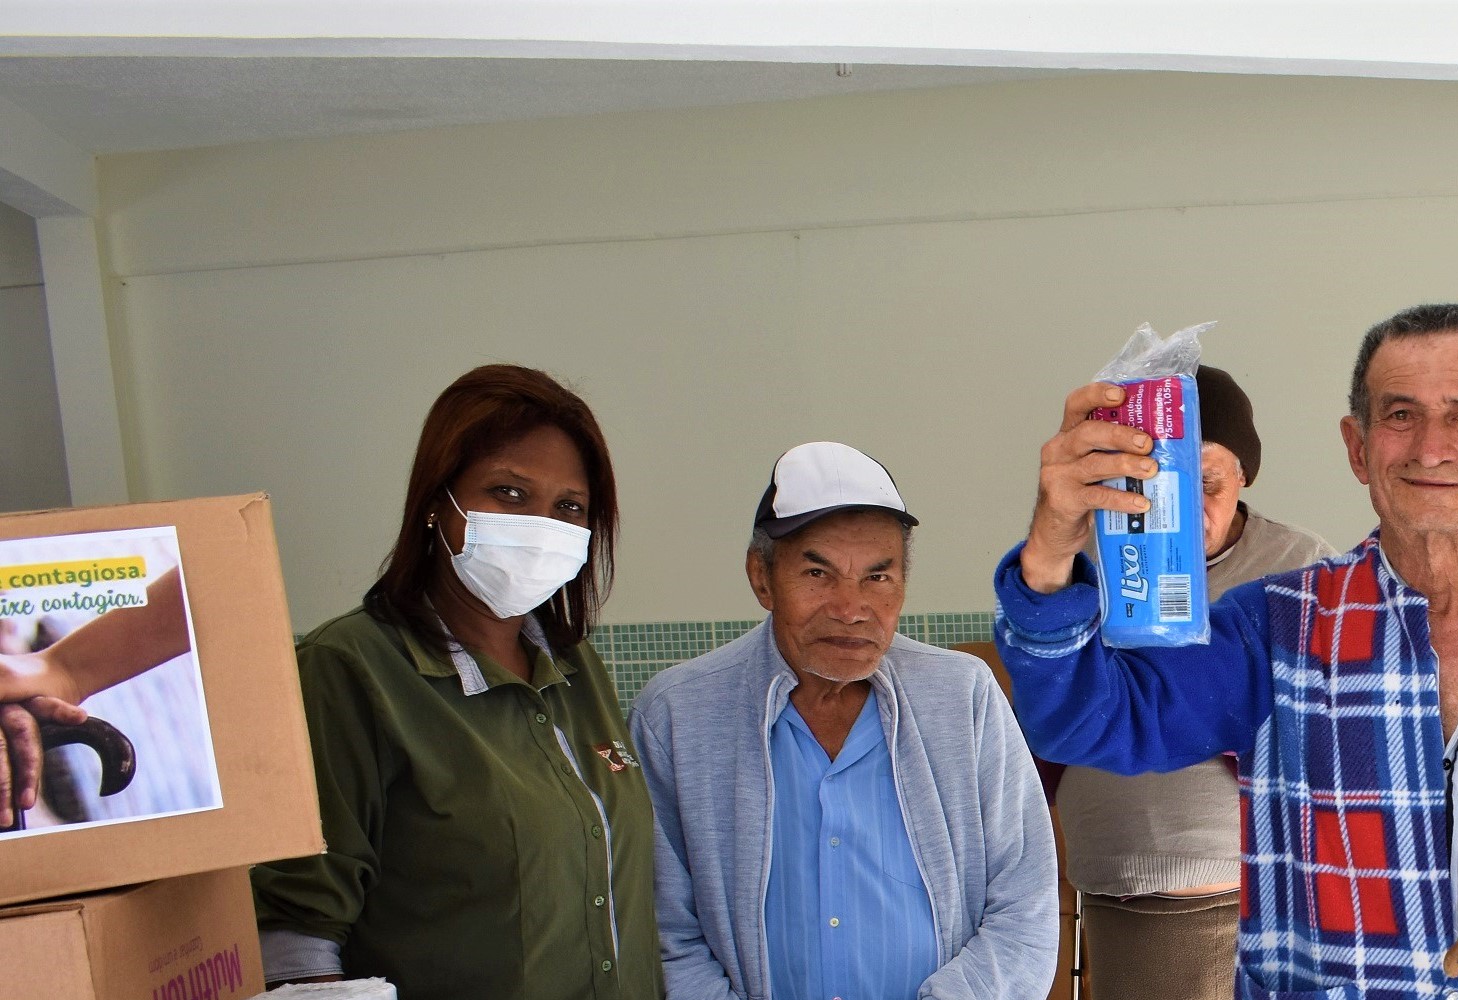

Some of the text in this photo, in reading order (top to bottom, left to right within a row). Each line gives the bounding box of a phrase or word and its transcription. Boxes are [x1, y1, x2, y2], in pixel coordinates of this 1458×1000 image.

[1135, 384, 1145, 424] unidades
[1165, 416, 1174, 438] 75cm
[9, 563, 146, 588] contagiosa.
[1121, 544, 1149, 602] Lixo
[42, 590, 144, 614] contagiar.
